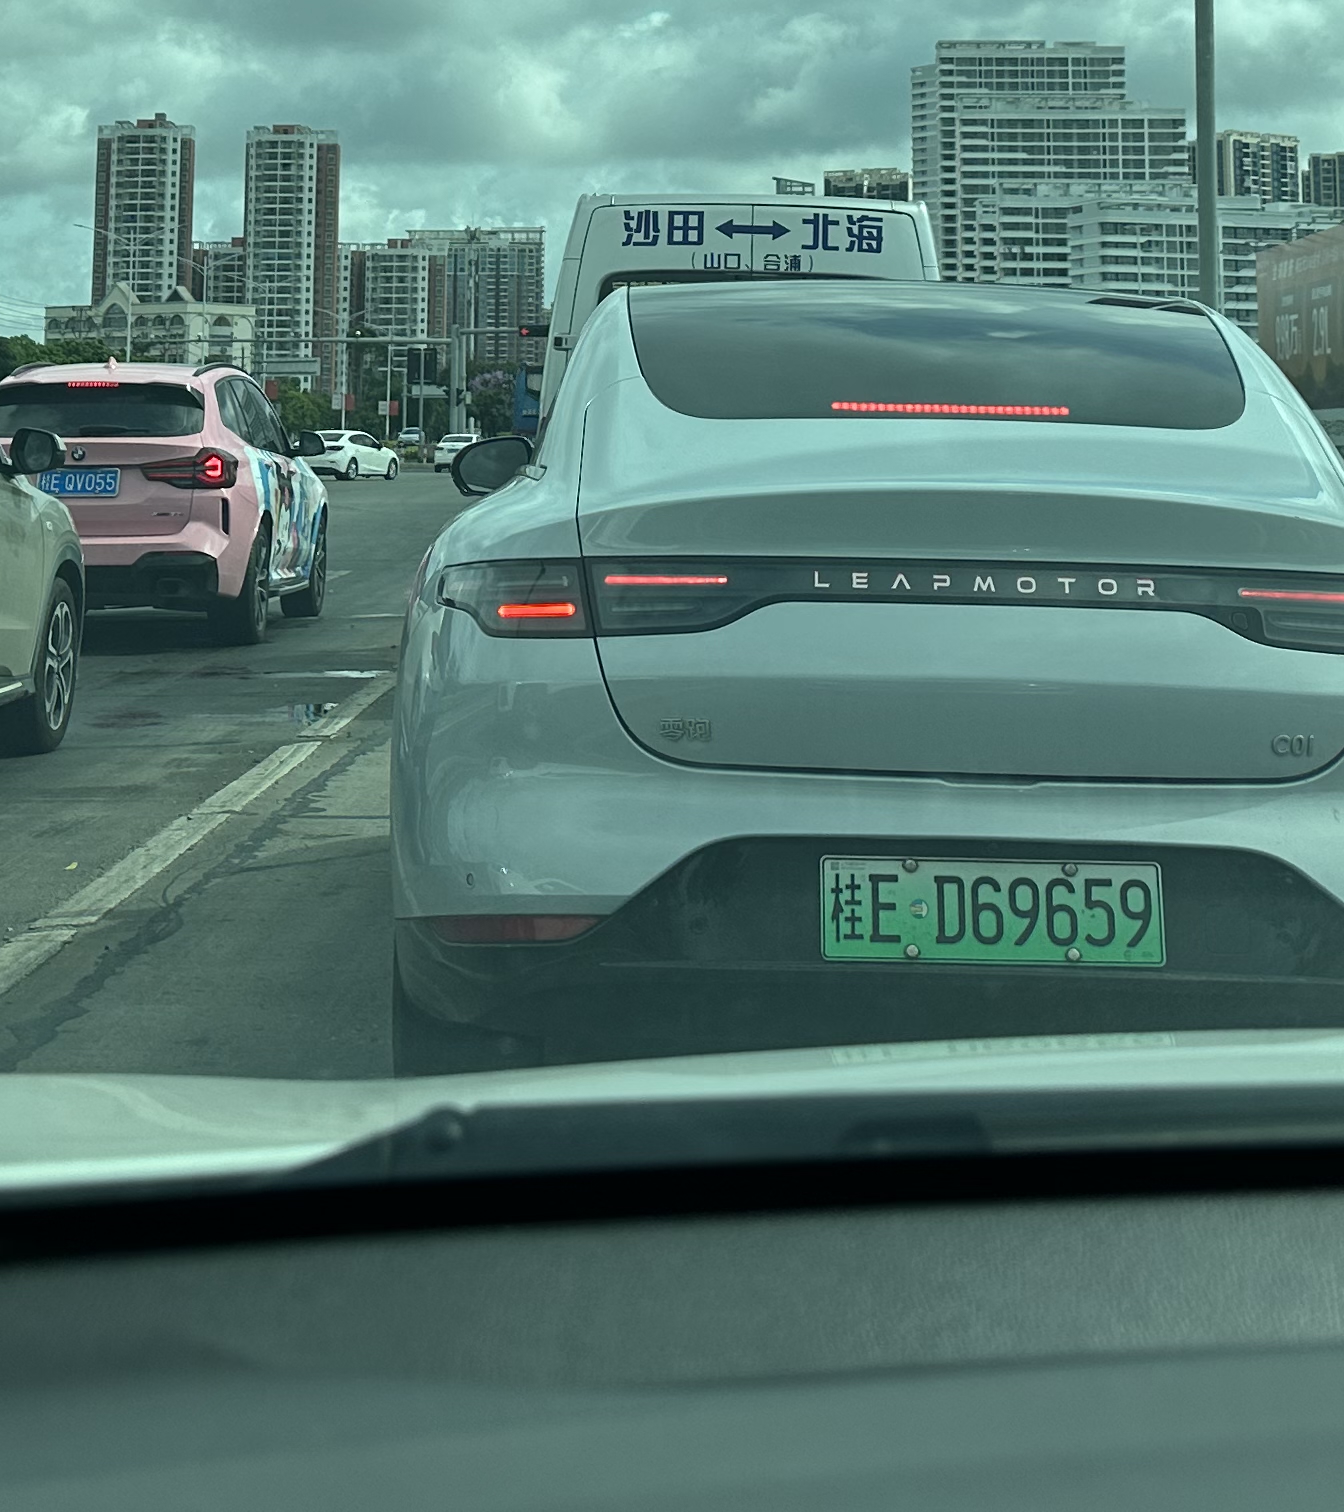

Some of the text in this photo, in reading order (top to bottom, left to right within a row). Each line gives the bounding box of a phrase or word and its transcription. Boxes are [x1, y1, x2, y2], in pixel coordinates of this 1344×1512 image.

[622, 209, 885, 255] 沙田 北海
[813, 570, 1155, 597] LEAPMOTOR
[659, 717, 712, 742] 零跑
